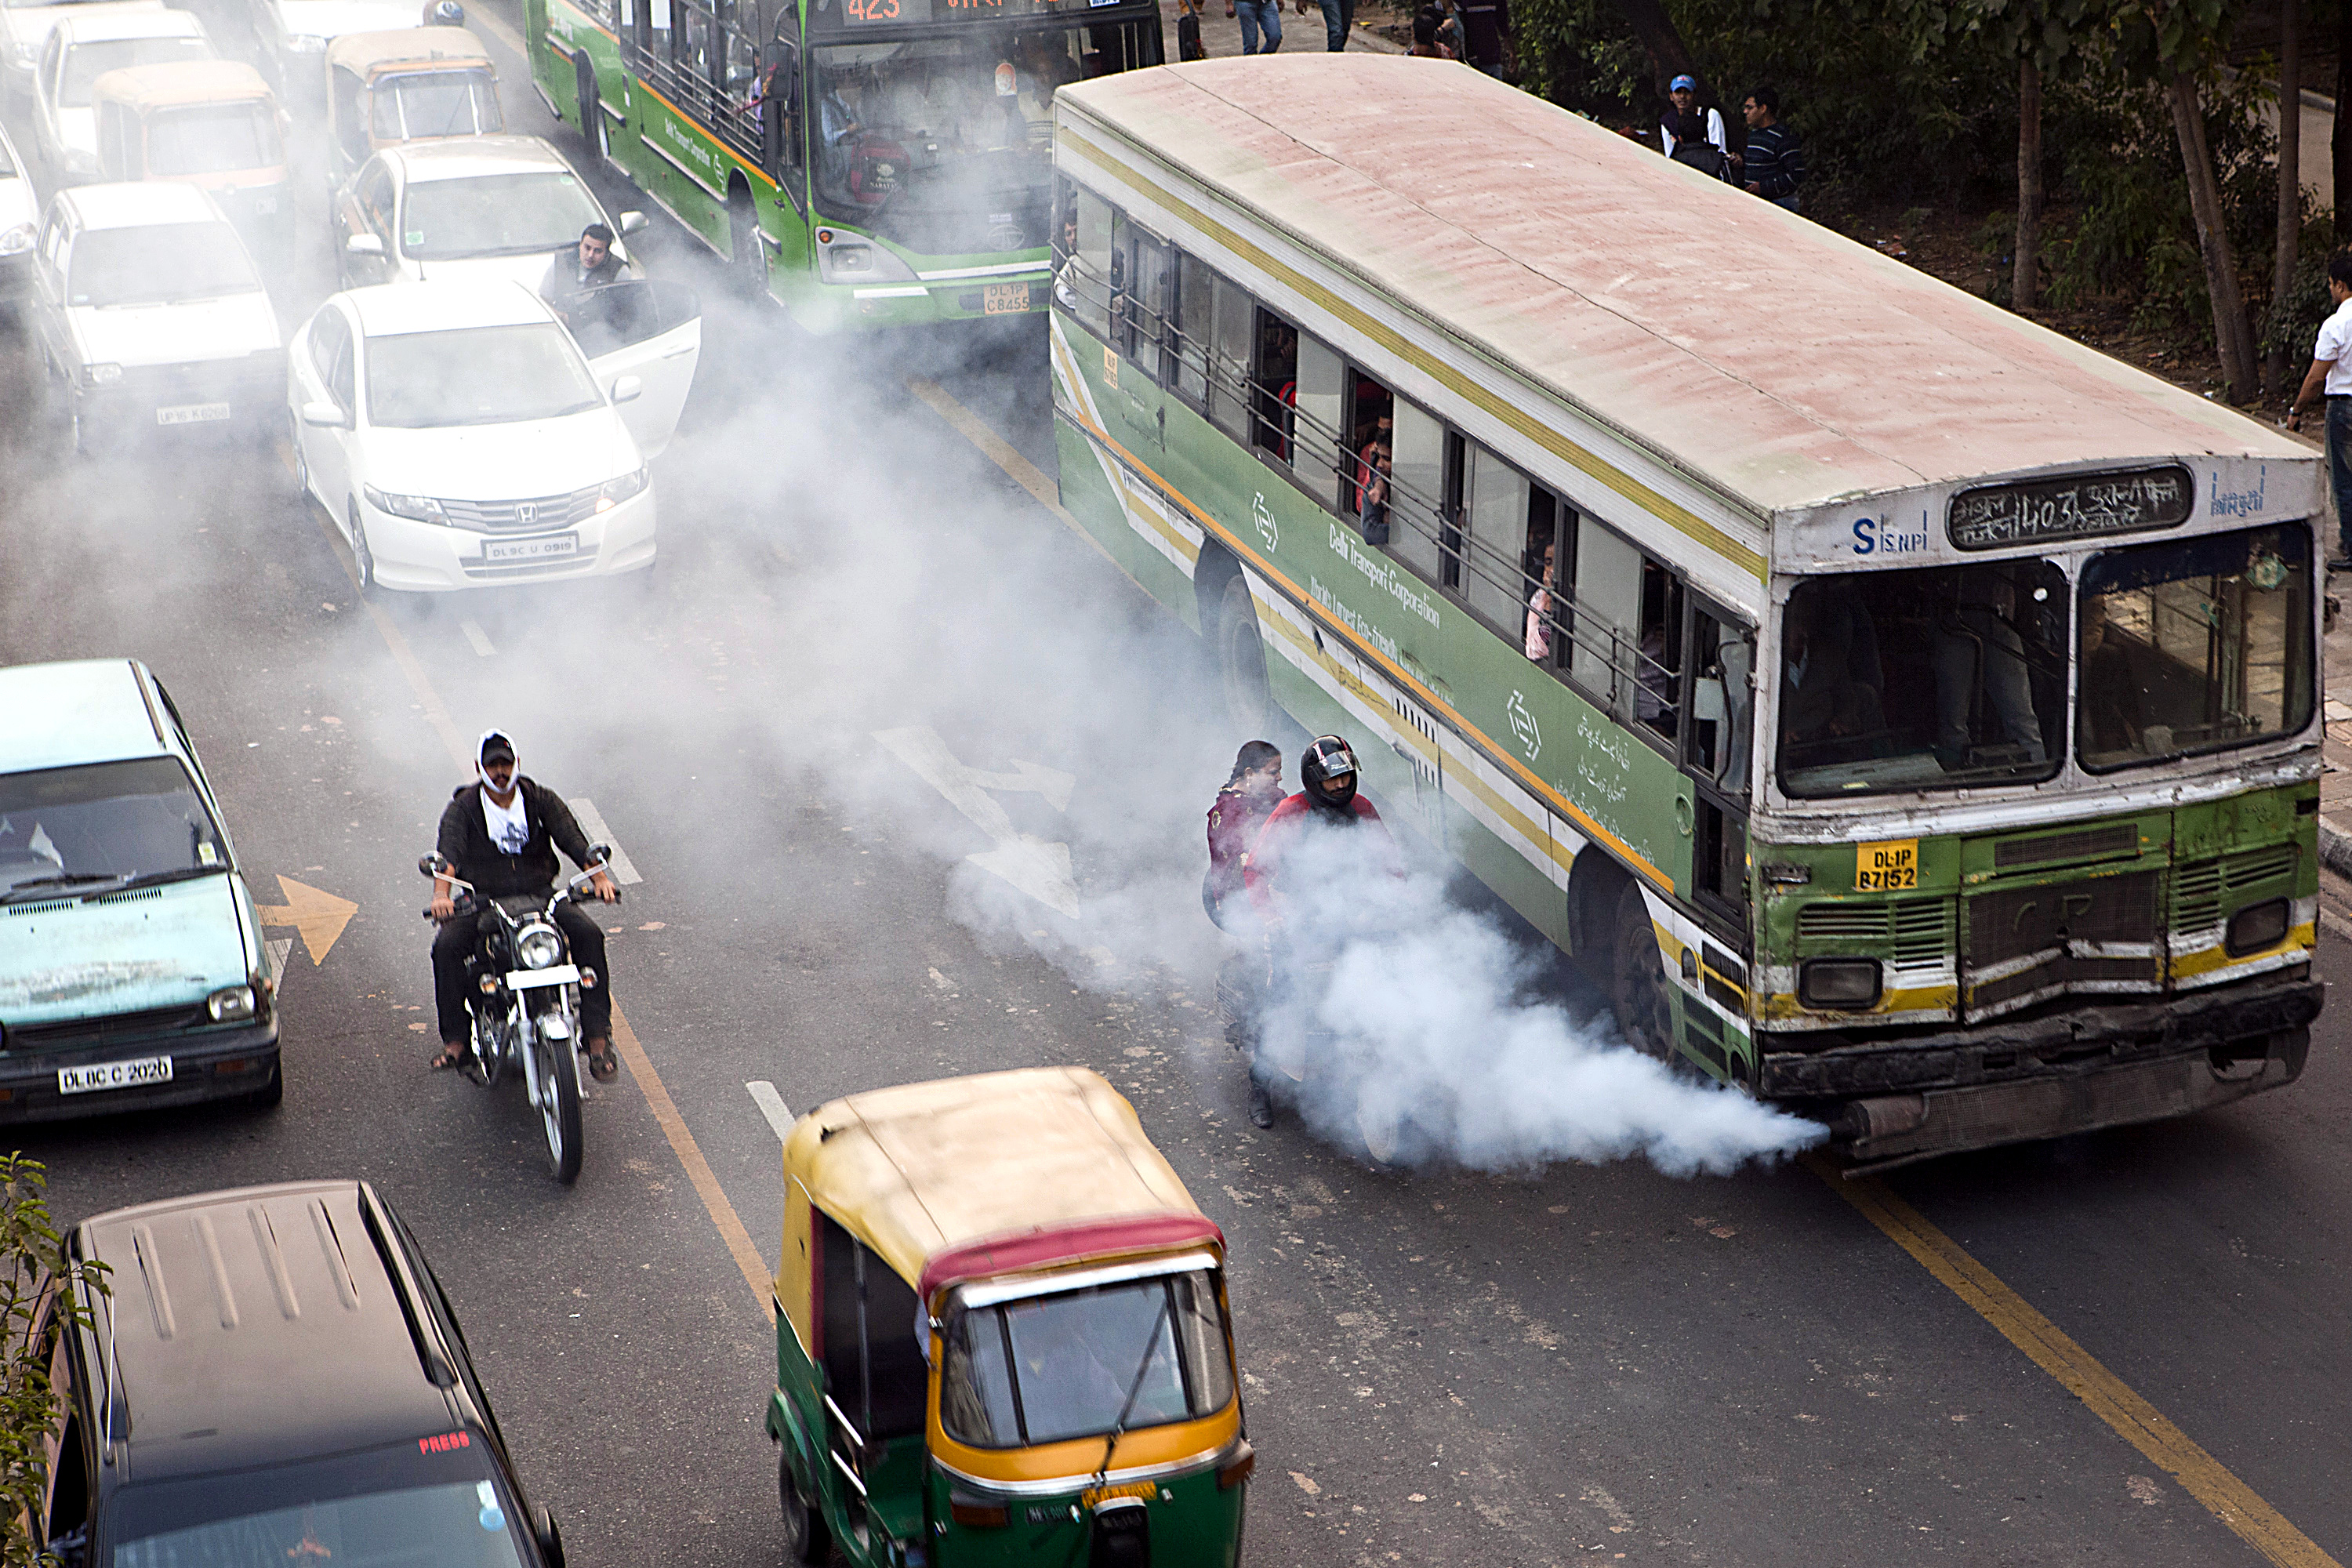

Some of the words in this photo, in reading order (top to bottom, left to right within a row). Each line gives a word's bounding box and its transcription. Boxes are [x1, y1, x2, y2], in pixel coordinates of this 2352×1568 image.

[849, 0, 900, 21] 423
[987, 296, 1029, 312] C8455
[1853, 517, 1876, 554] S
[492, 548, 506, 557] DL
[530, 545, 538, 554] U
[1330, 522, 1348, 561] Delhi
[1350, 538, 1388, 591] Transport
[1389, 568, 1440, 629] Corporation
[1860, 867, 1915, 889] B7152
[64, 1069, 85, 1089] DL
[111, 1065, 122, 1083] C
[128, 1059, 168, 1082] 2020
[419, 1431, 470, 1455] PRESS
